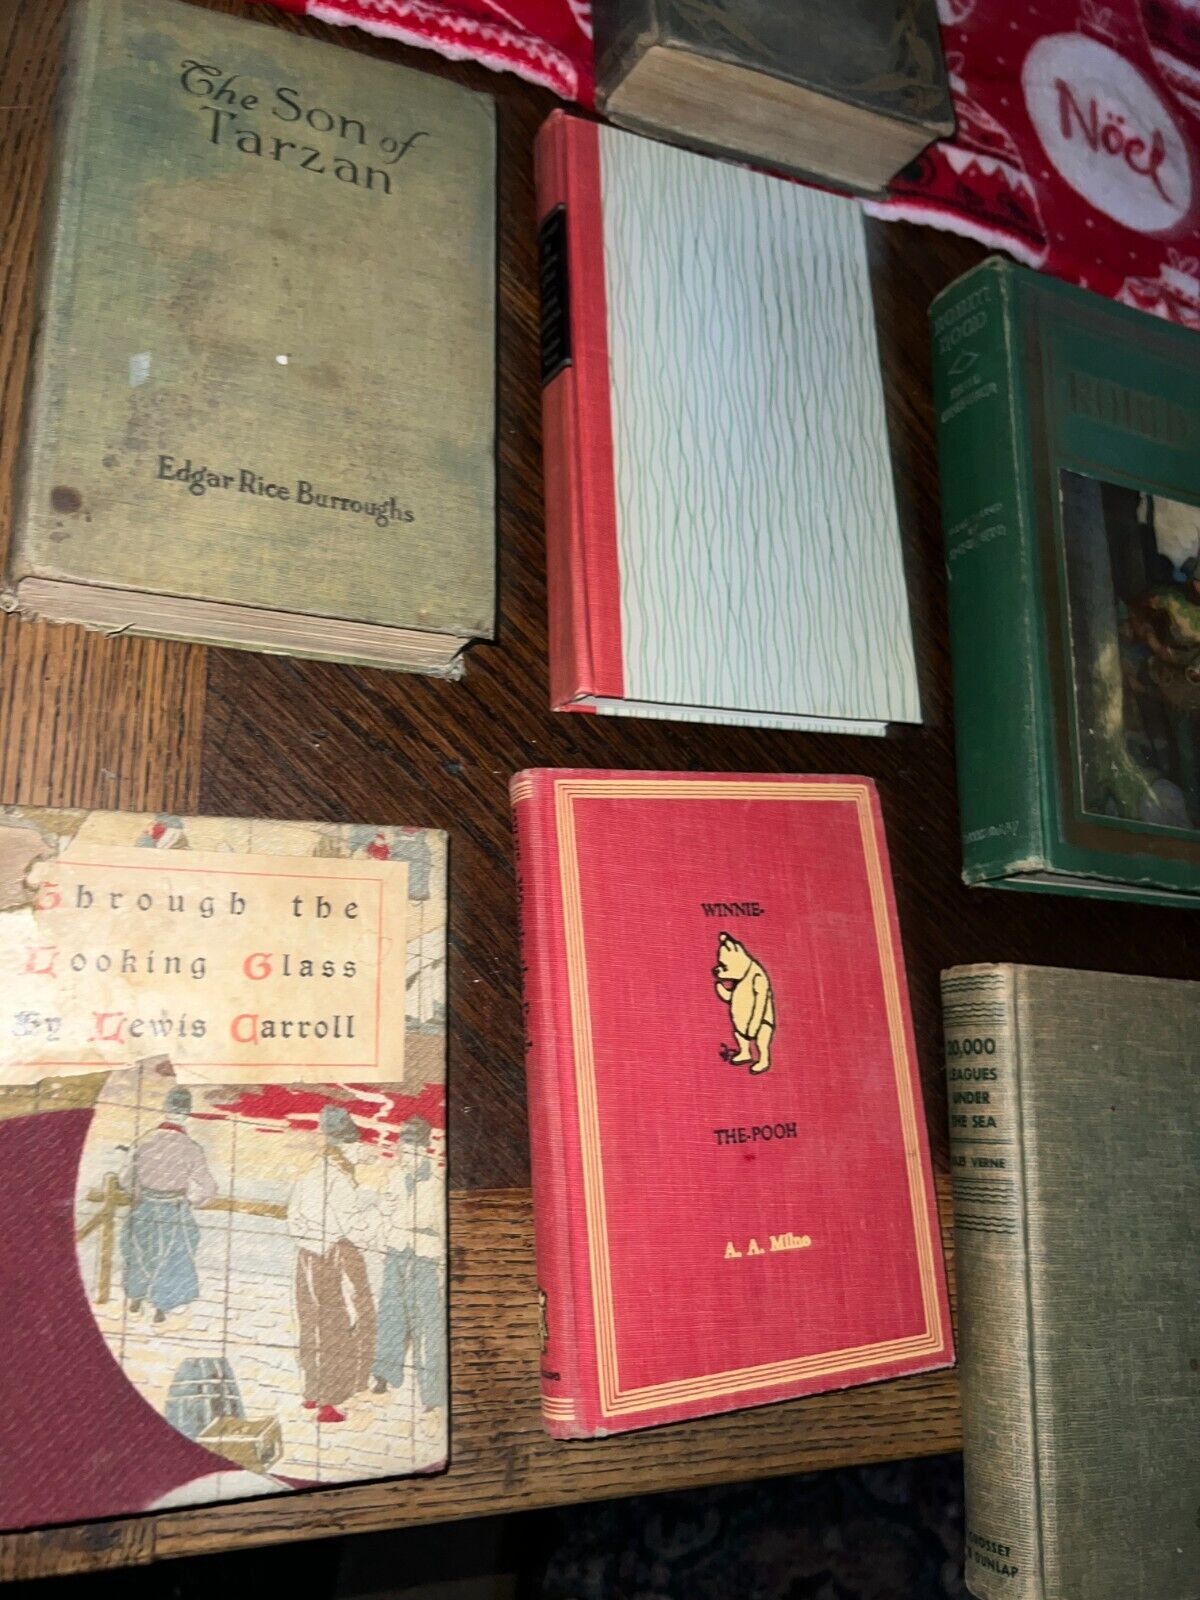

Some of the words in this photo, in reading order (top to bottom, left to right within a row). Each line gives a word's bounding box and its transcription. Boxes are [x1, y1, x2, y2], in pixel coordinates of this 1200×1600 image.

[180, 59, 259, 110] The
[272, 87, 367, 145] Son
[379, 131, 430, 164] of
[200, 105, 392, 195] Tarzan
[158, 455, 234, 496] Edgar
[238, 469, 290, 501] Rice
[296, 480, 415, 527] Burroughs
[292, 895, 358, 919] the
[701, 903, 764, 917] WINNIE-
[18, 945, 206, 979] Looking
[242, 952, 357, 980] Glass
[87, 1009, 207, 1044] Lewis
[230, 1013, 355, 1045] Carroll
[972, 1114, 997, 1128] SEA
[971, 1157, 1006, 1168] VERNE
[724, 1241, 742, 1259] A.
[746, 1238, 765, 1255] A.
[769, 1232, 811, 1251] Milne
